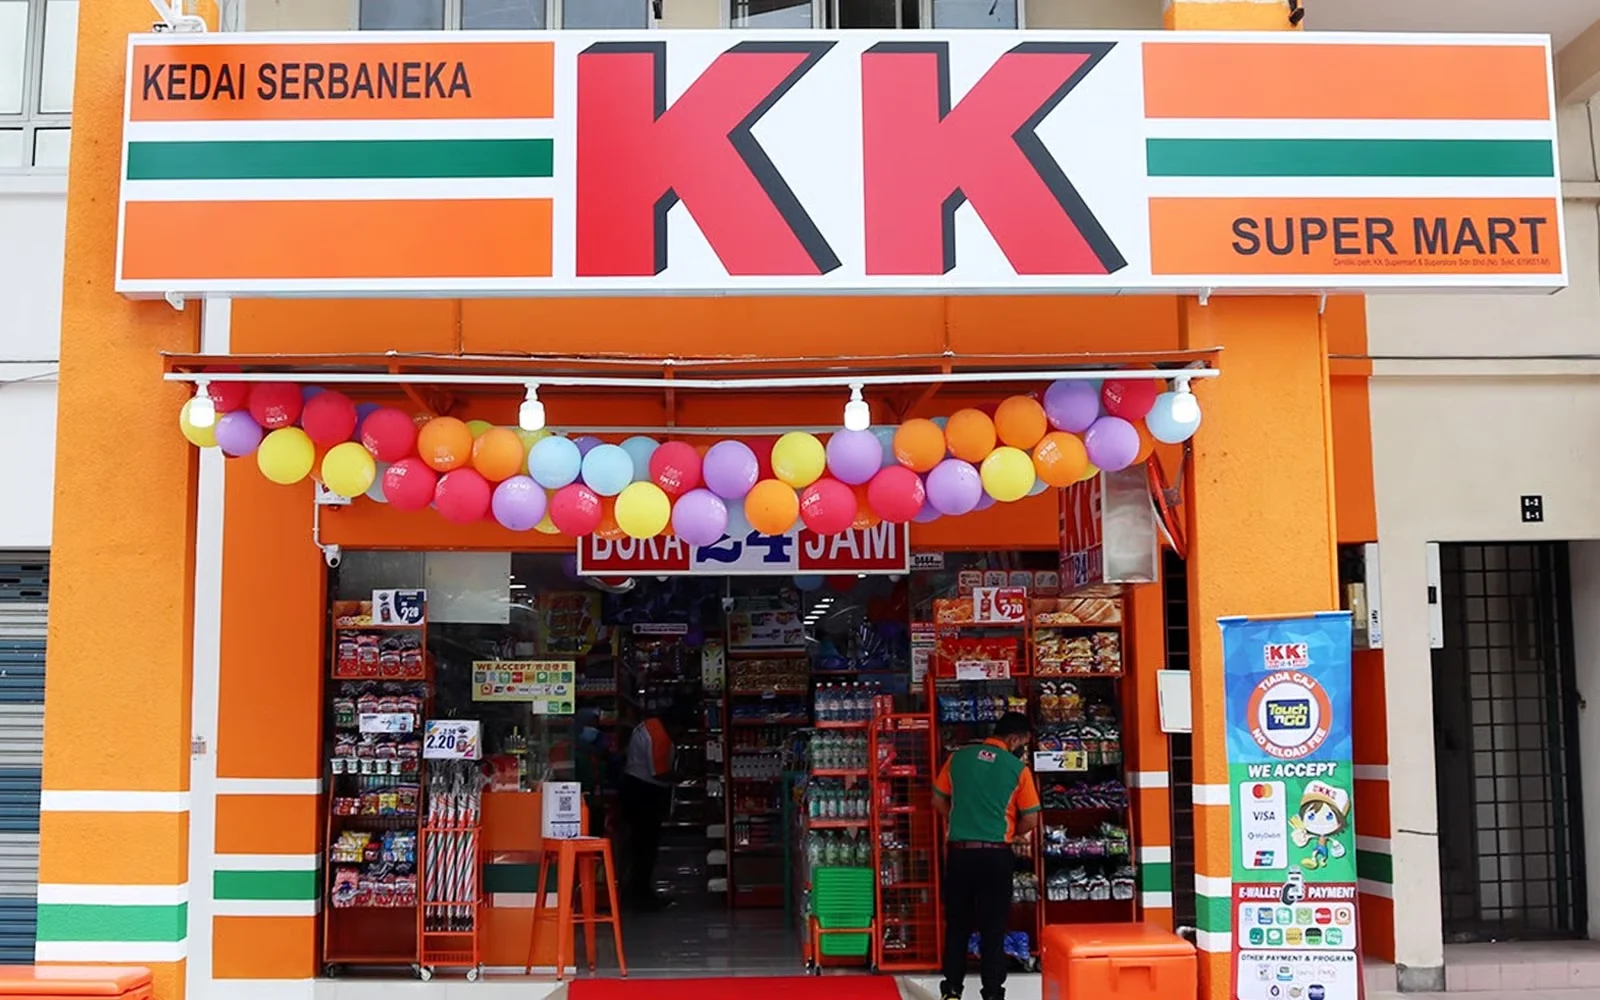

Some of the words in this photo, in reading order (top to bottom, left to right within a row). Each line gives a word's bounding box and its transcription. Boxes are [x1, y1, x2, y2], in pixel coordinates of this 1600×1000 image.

[143, 63, 245, 100] KEDAI
[257, 62, 471, 100] SERBANEKA
[576, 41, 1128, 277] KK
[1232, 216, 1398, 256] SUPER
[1413, 216, 1548, 255] MART
[476, 663, 493, 671] WE
[1258, 671, 1291, 691] TIADA
[1293, 673, 1316, 689] CAJ
[1268, 703, 1308, 716] Touch
[426, 735, 456, 750] 2.20
[1252, 728, 1266, 745] NO
[1265, 743, 1308, 758] RELOAD
[1248, 765, 1270, 778] WE
[1274, 763, 1337, 778] ACCEPT
[1252, 811, 1276, 821] VISA
[1308, 886, 1356, 898] PAYMENT
